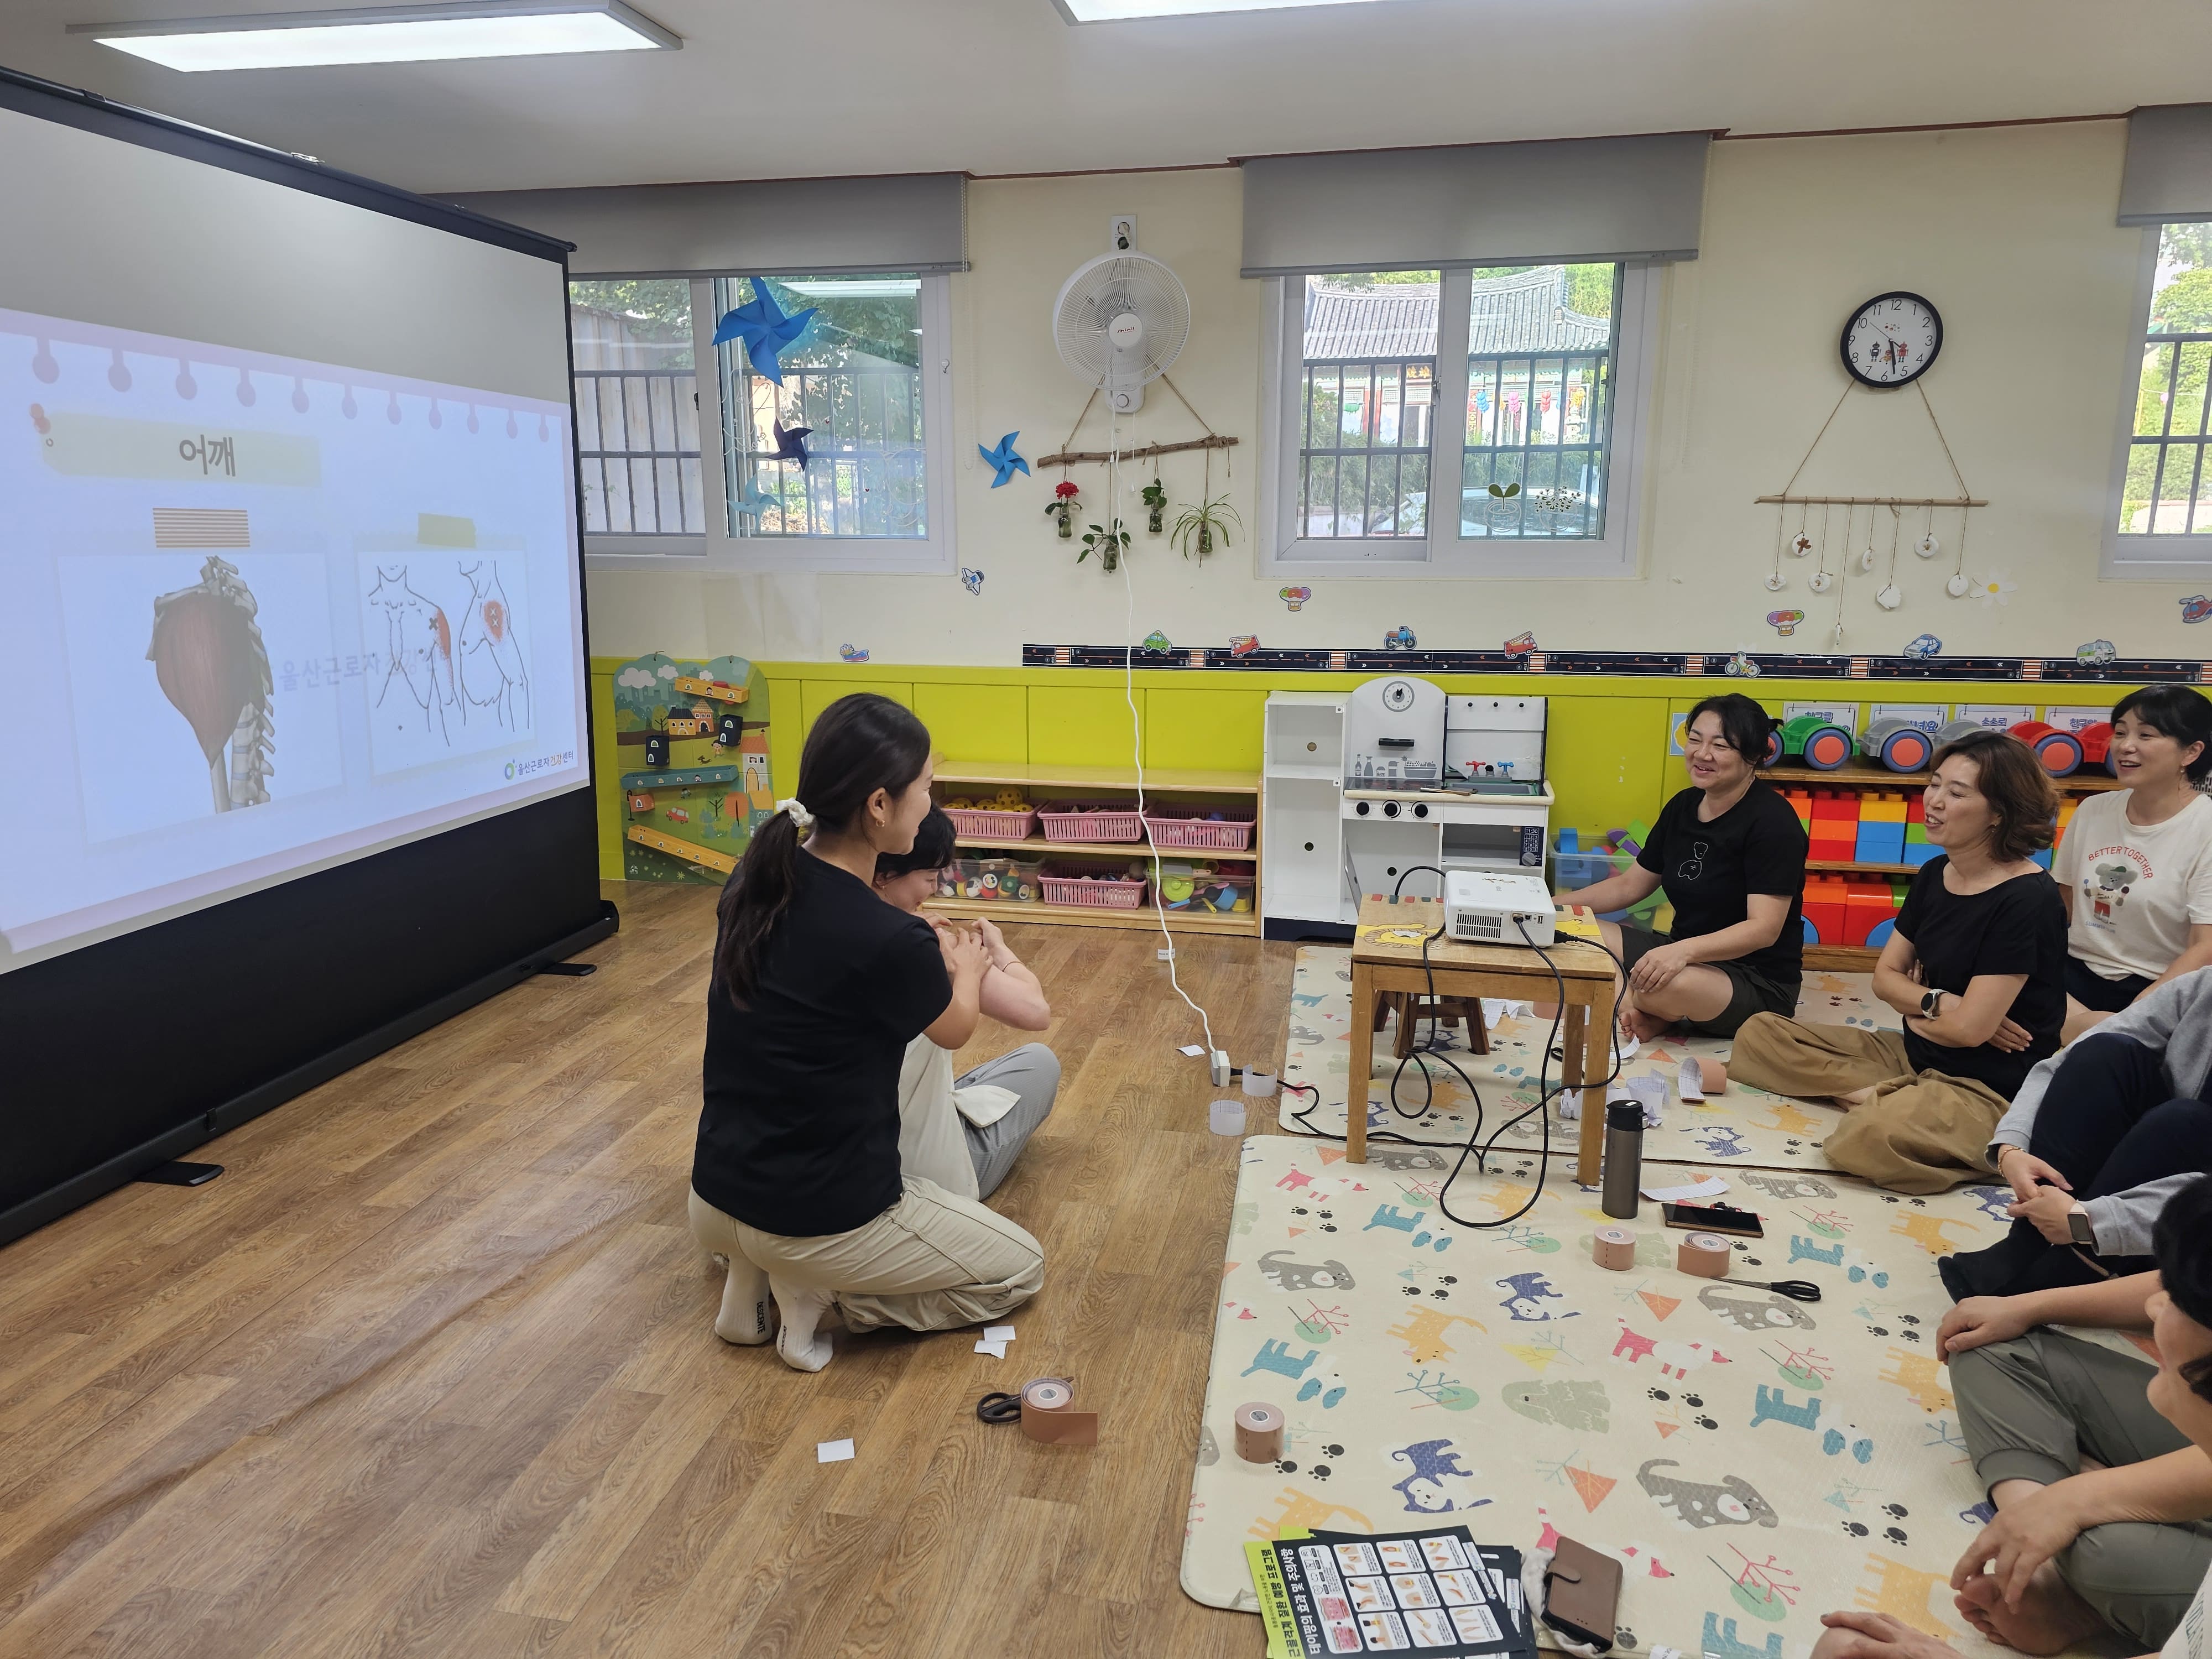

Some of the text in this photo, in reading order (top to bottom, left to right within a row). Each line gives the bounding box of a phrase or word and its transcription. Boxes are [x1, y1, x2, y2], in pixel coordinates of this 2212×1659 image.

[1891, 299, 1902, 310] 12
[1913, 304, 1917, 316] 1
[1873, 305, 1881, 316] 11
[1858, 317, 1867, 328] 10
[1922, 317, 1931, 328] 2
[1848, 335, 1855, 346] 9
[1924, 335, 1933, 346] 3
[1850, 352, 1859, 363] 8
[1915, 353, 1923, 364] 4
[1864, 366, 1872, 377] 7
[1881, 371, 1888, 381] 6
[1900, 366, 1908, 377] 5
[179, 434, 236, 477] 어깨
[1981, 717, 2007, 726] 스스로
[2088, 846, 2153, 880] BETTER TOGETHER
[757, 1301, 766, 1335] DESCENTE
[1261, 1549, 1301, 1658] 근골격계 질환 예방 프로그램
[1280, 1548, 1322, 1655] 테이핑의 효과 및 주의사항
